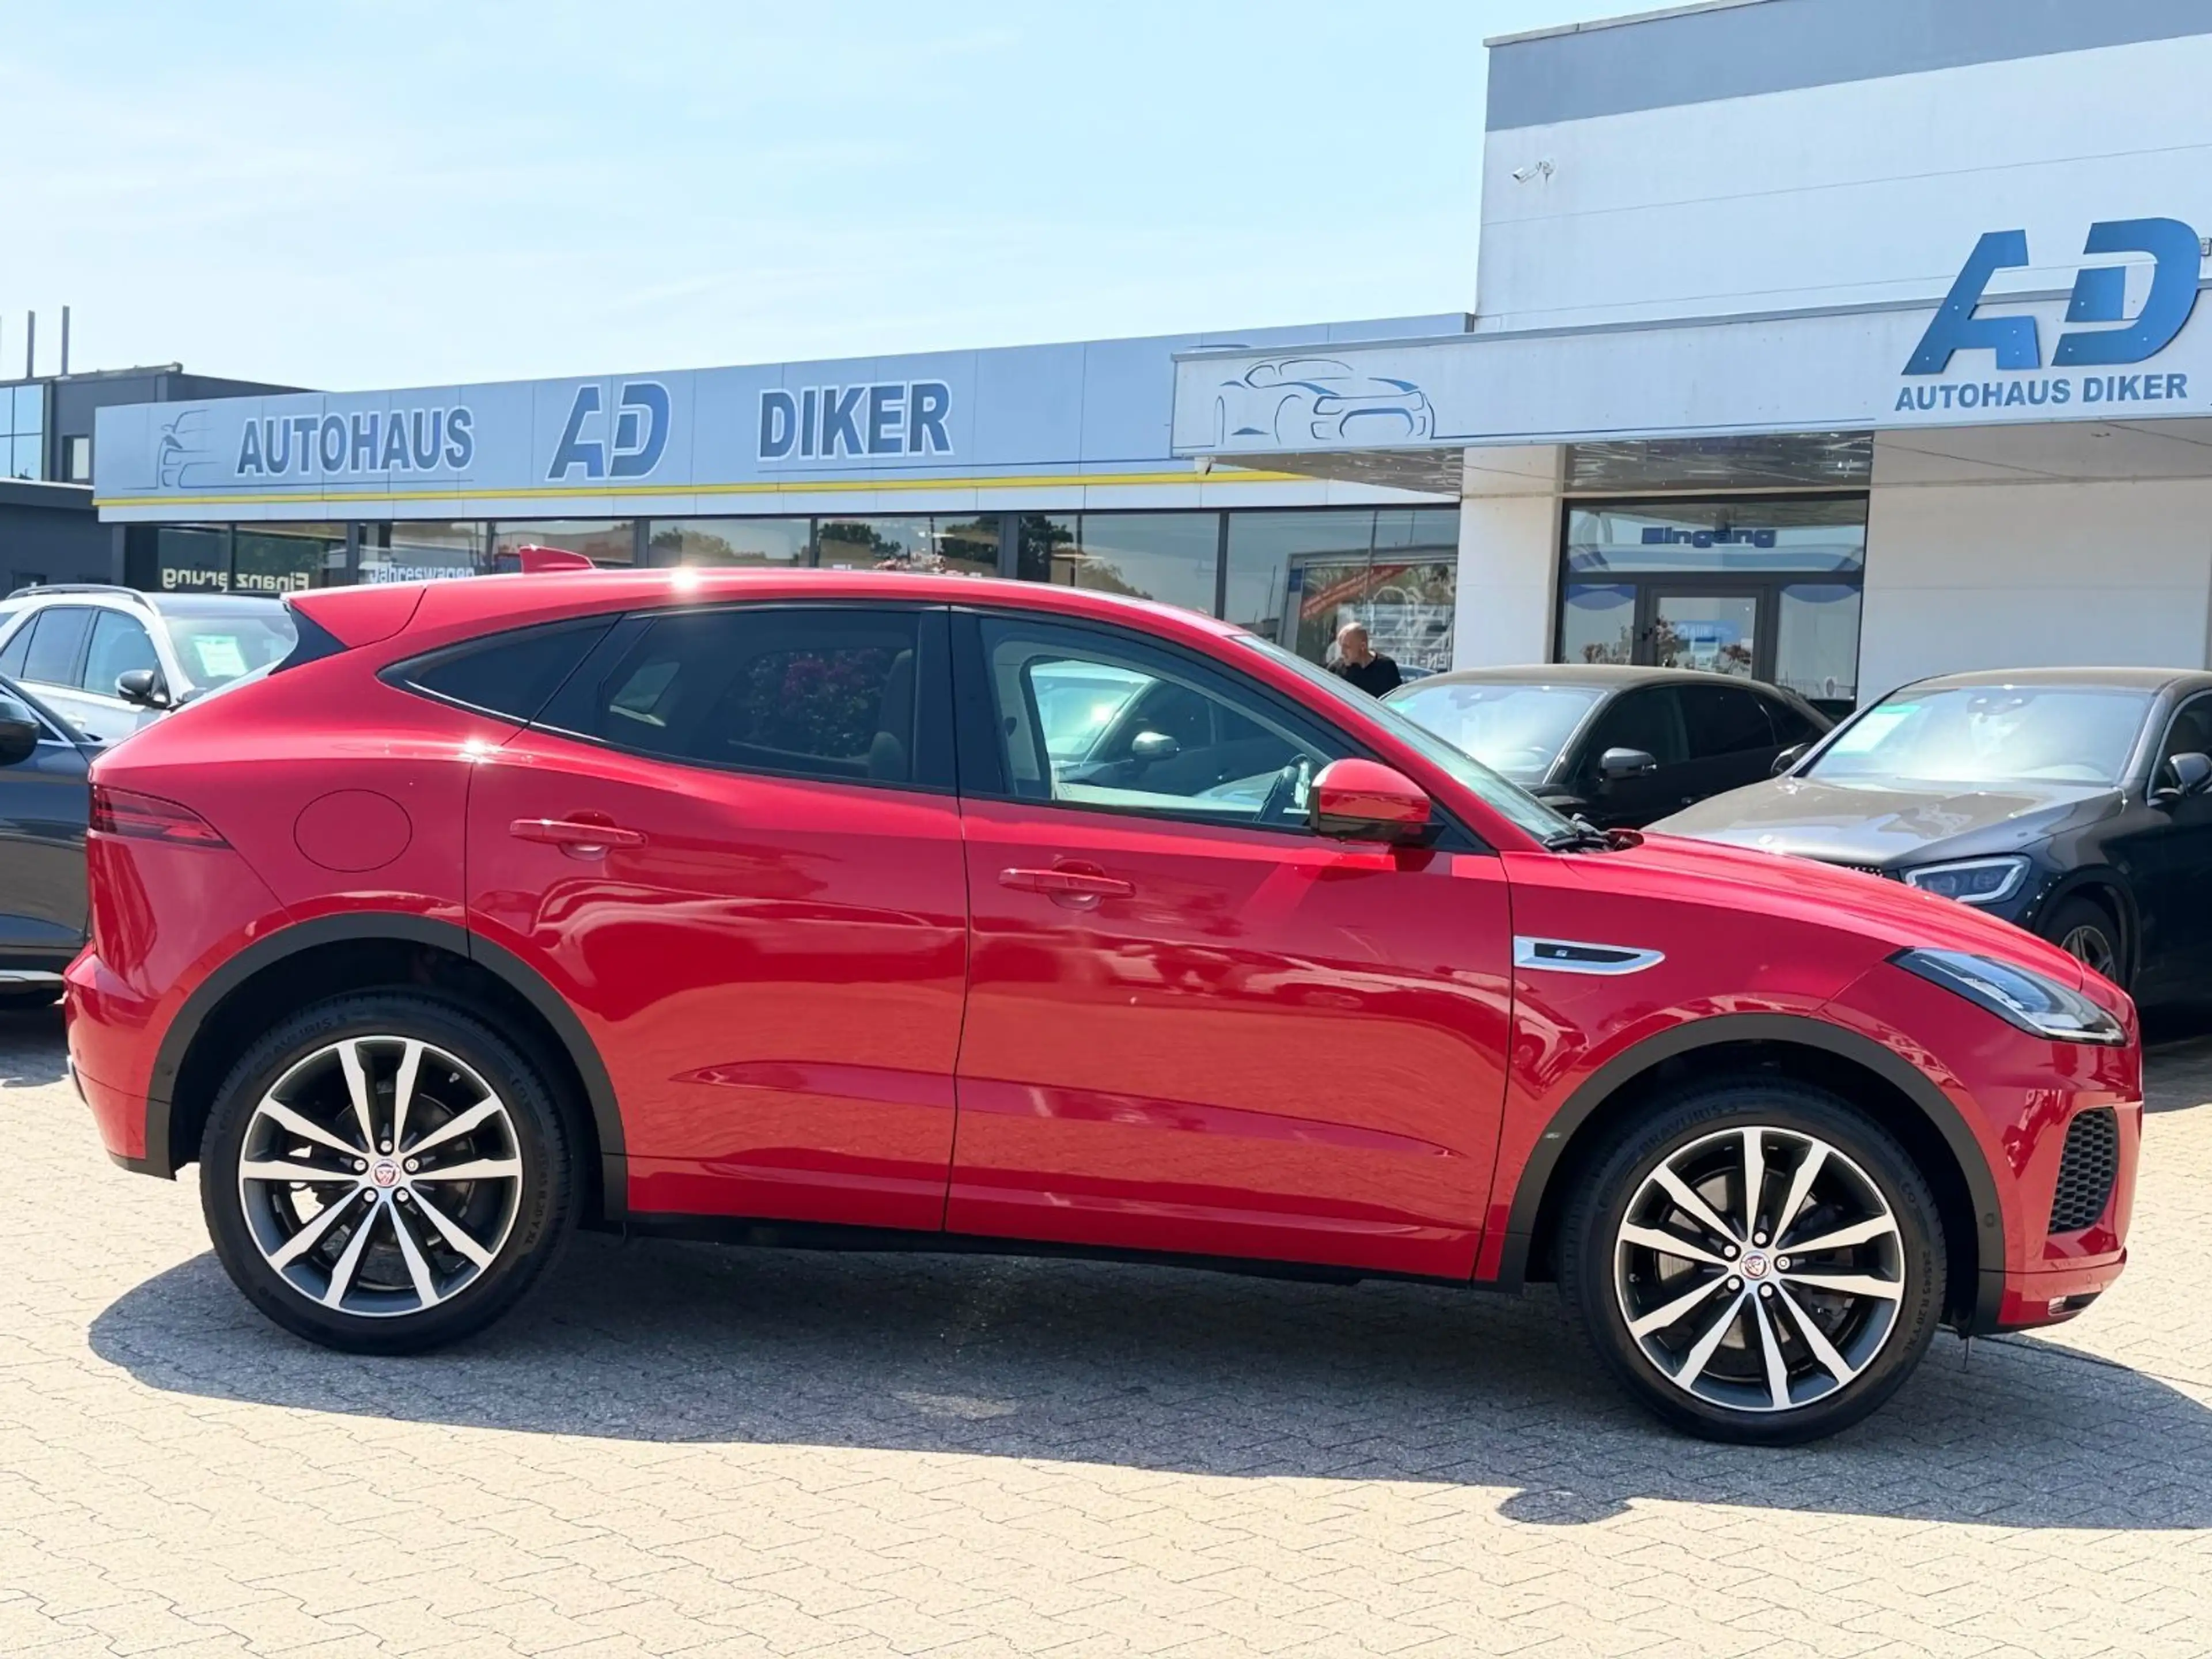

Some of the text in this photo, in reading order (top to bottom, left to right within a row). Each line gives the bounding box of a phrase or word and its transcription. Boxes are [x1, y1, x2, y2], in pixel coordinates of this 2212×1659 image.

[1902, 217, 2200, 376] AD
[235, 379, 954, 481] AUTOHAUS AD DIKER
[1895, 373, 2188, 412] AUTOHAUS DIKER
